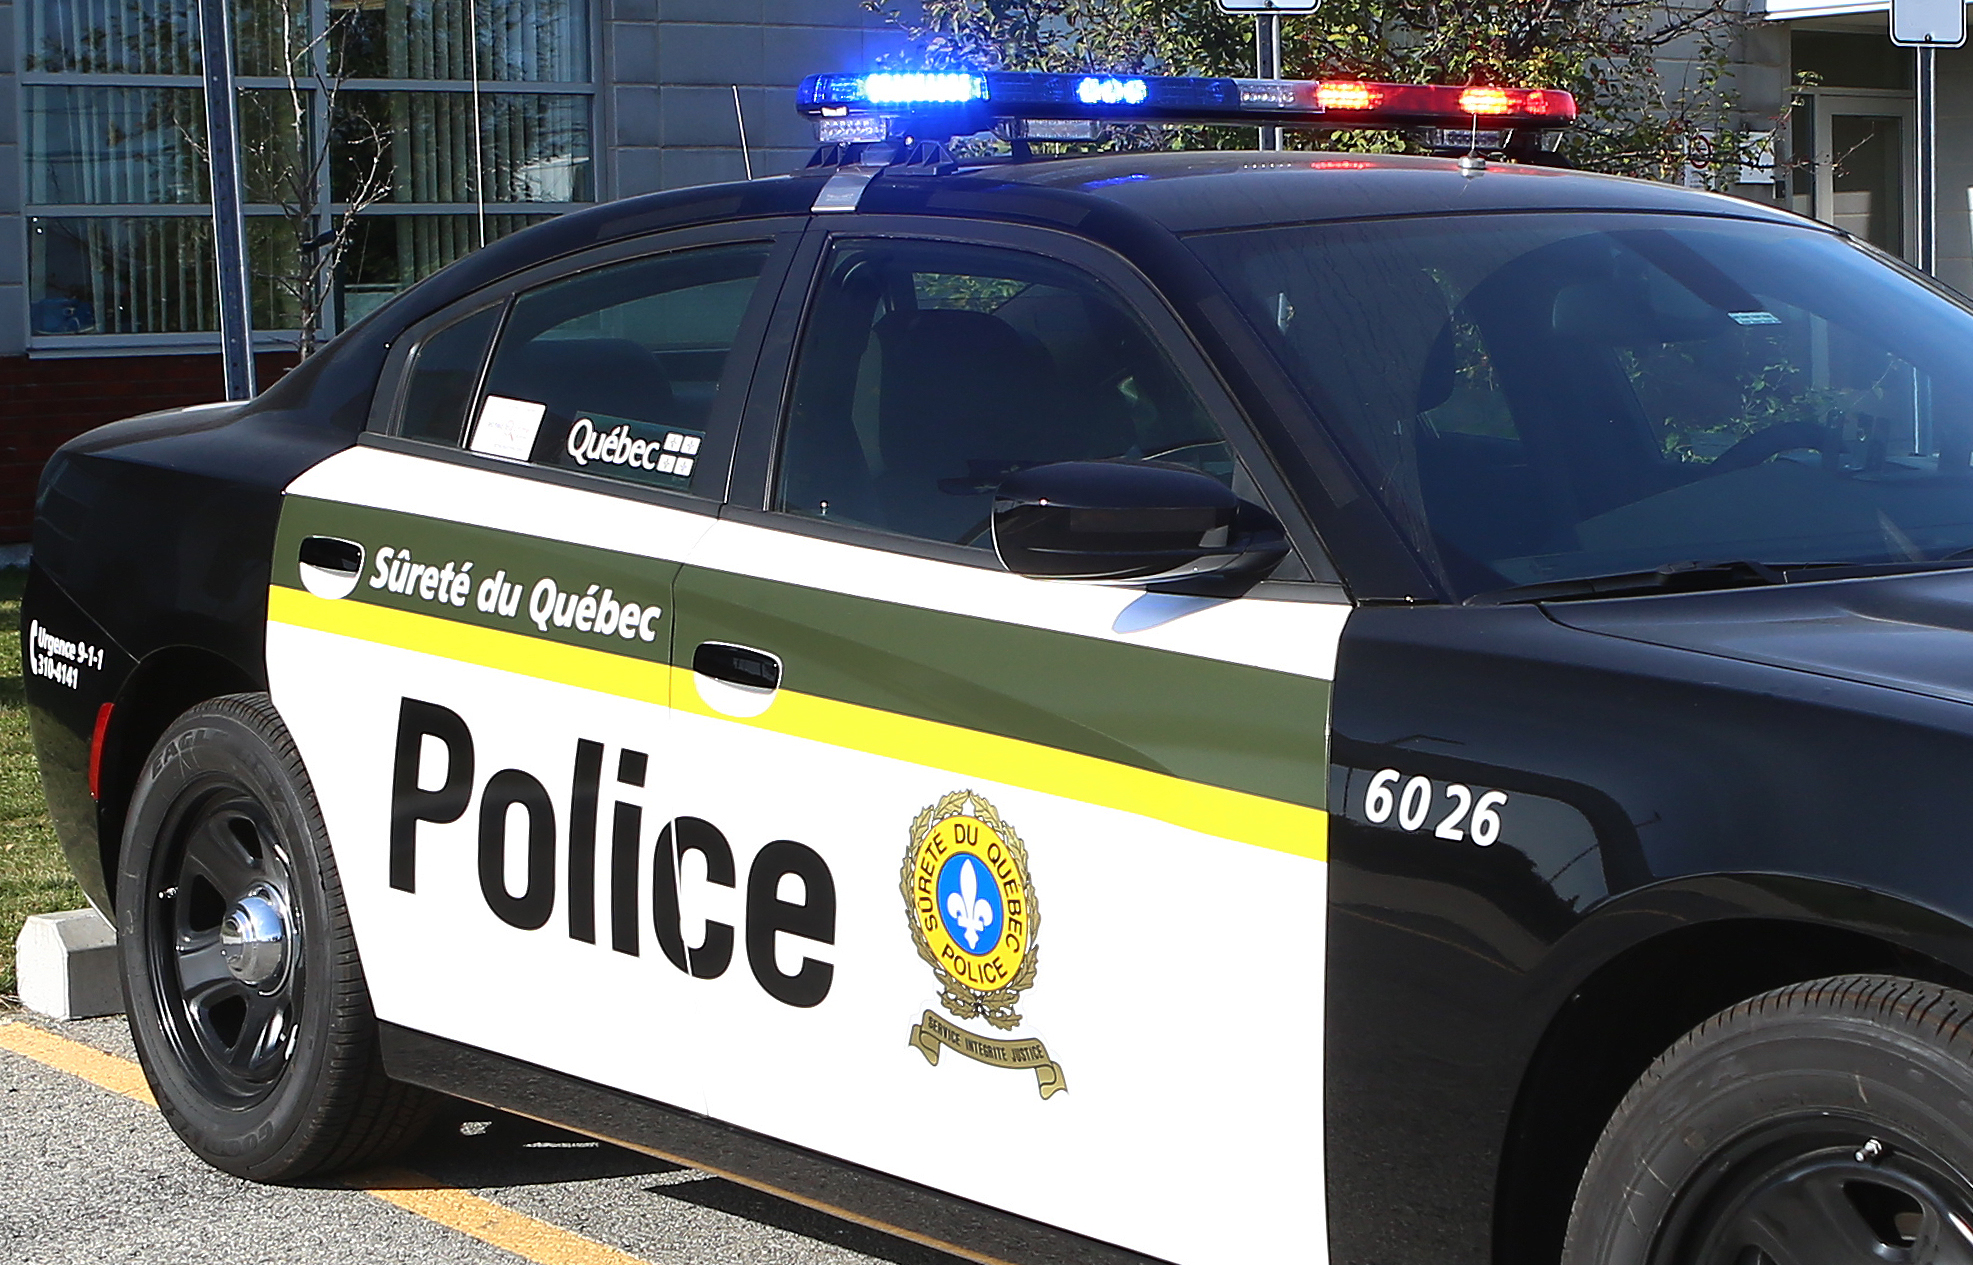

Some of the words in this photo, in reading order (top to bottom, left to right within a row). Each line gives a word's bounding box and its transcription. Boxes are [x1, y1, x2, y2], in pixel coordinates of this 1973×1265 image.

[567, 418, 660, 470] Québec
[369, 546, 474, 606] Sûreté
[477, 570, 523, 617] du
[529, 577, 662, 642] Québec
[37, 626, 76, 660] Urgence
[77, 641, 104, 670] 9-1-1
[38, 653, 79, 690] 310-4141
[389, 696, 837, 1008] Police
[954, 823, 979, 847] DU
[987, 843, 1022, 954] QUÉBEC
[941, 943, 1008, 984] POLICE
[928, 1015, 961, 1046] SERVICE
[1011, 1044, 1045, 1062] JUSTICE
